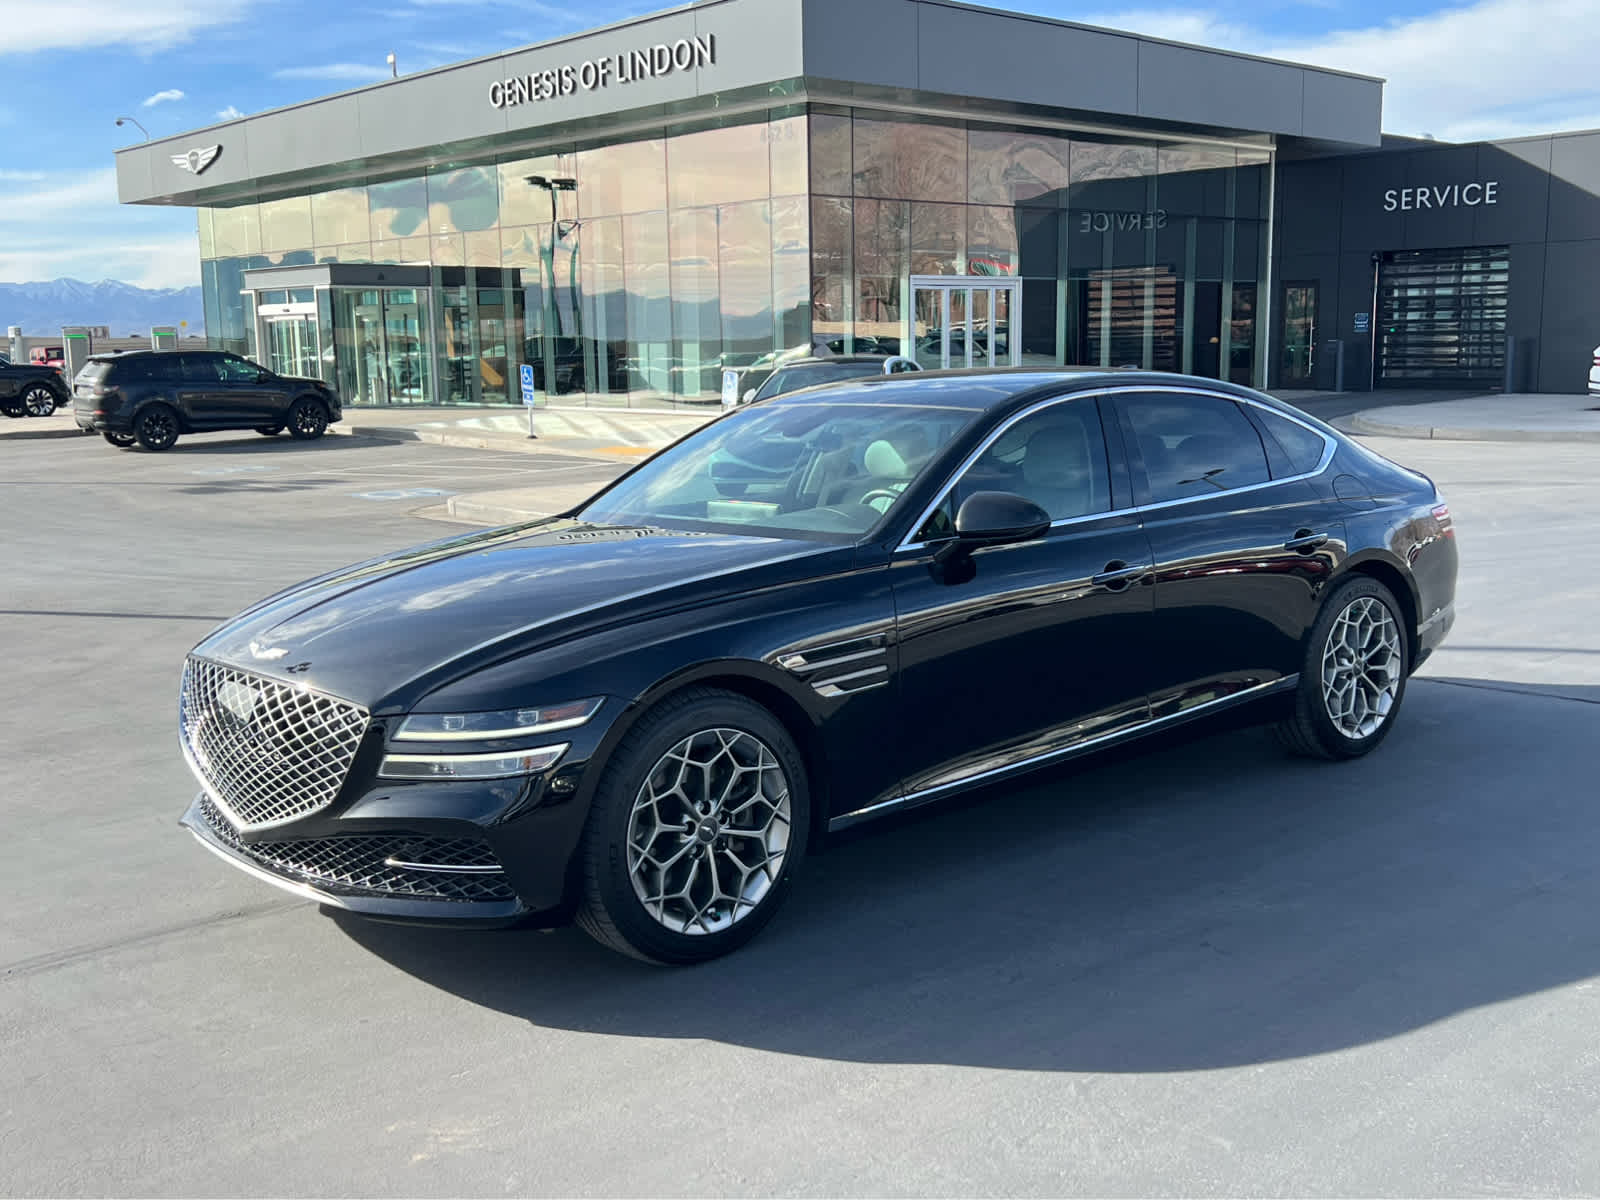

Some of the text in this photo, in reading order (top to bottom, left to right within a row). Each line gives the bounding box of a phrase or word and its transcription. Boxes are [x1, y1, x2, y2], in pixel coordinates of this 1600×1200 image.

[489, 33, 714, 108] GENESIS OF LINDON
[1383, 181, 1498, 211] SERVICE
